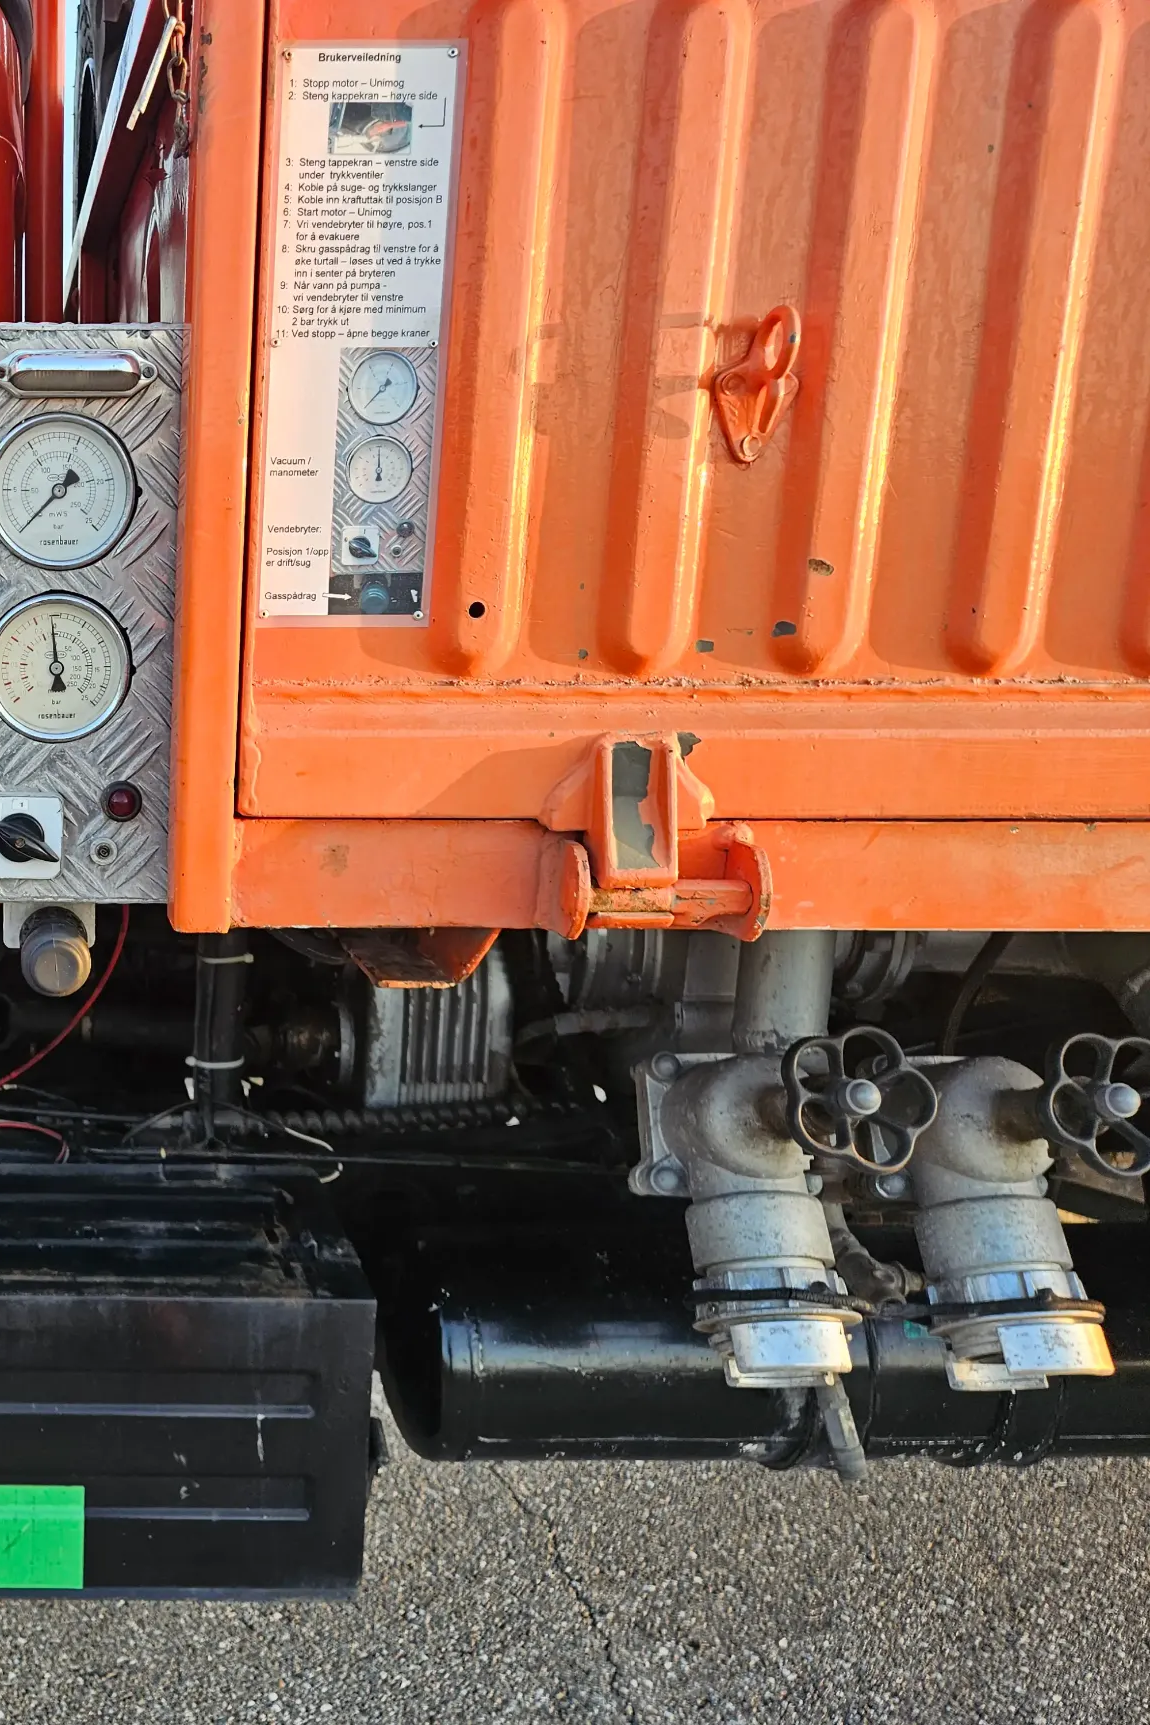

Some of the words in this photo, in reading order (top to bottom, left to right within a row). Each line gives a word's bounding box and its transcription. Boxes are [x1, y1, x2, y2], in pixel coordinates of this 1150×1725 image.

[318, 53, 401, 63] Brukerveiledning
[290, 79, 297, 87] 1:
[303, 79, 330, 89] Stopp
[332, 79, 358, 88] motor
[369, 78, 405, 89] Unimog
[288, 92, 296, 100] 2:
[302, 92, 329, 102] Steng
[332, 92, 379, 102] kappekran
[390, 91, 416, 102] høyre
[418, 91, 438, 100] side
[286, 158, 294, 167] 3:
[300, 158, 326, 168] Steng
[328, 158, 373, 168] tappekran
[384, 159, 417, 167] venstre
[420, 158, 439, 167] side
[299, 171, 325, 179] under
[330, 171, 384, 181] trykkventiler
[284, 184, 292, 192] 4:
[326, 183, 338, 193] på
[341, 185, 365, 194] suge-
[368, 186, 379, 194] og
[382, 183, 437, 193] trykkslanger
[284, 196, 292, 204] 5:
[298, 196, 323, 204] Koble
[326, 196, 339, 204] inn
[342, 196, 383, 204] kraftuttak
[386, 196, 394, 204] til
[396, 196, 433, 206] posisjon
[436, 195, 442, 203] B
[283, 208, 291, 216] 6:
[298, 208, 318, 217] Start
[321, 208, 347, 216] motor
[358, 208, 392, 218] Unimog
[283, 220, 291, 228] 7:
[297, 220, 308, 228] Vri
[312, 220, 364, 230] vendebryter
[296, 232, 308, 241] for
[311, 232, 316, 241] å
[318, 233, 360, 241] evakuere
[282, 245, 289, 253] 8:
[295, 244, 316, 253] Skru
[318, 244, 371, 255] gasspådrag
[418, 244, 430, 252] for
[294, 257, 312, 265] øke
[314, 257, 338, 265] turtall
[350, 257, 373, 265] løses
[376, 257, 384, 265] ut
[387, 257, 403, 265] ved
[406, 257, 411, 265] å
[414, 257, 441, 267] trykke
[294, 269, 307, 277] inn
[345, 269, 357, 279] på
[359, 269, 395, 279] bryteren
[294, 281, 310, 290] Når
[336, 281, 348, 291] på
[350, 282, 381, 291] pumpa
[293, 293, 303, 301] vri
[306, 293, 358, 303] vendebryter
[292, 305, 313, 315] Sørg
[316, 305, 328, 313] for
[339, 306, 361, 315] kjøre
[363, 305, 382, 313] med
[292, 318, 298, 326] 2
[300, 318, 314, 326] bar
[317, 318, 338, 328] trykk
[341, 318, 349, 326] ut
[276, 330, 288, 338] 11:
[292, 329, 309, 338] Ved
[312, 330, 335, 339] stopp
[347, 329, 368, 339] åpne
[371, 329, 399, 339] begge
[401, 329, 430, 338] kraner
[271, 457, 306, 465] Vacuum
[269, 469, 319, 477] manometer
[268, 525, 322, 534] Vendebryter:
[40, 535, 78, 545] rosenbauer
[266, 548, 302, 557] Posisjon
[305, 547, 328, 557] 1/opp
[277, 558, 311, 568] drift/sug
[265, 592, 317, 601] Gasspådrag
[38, 709, 75, 719] rosenbauer
